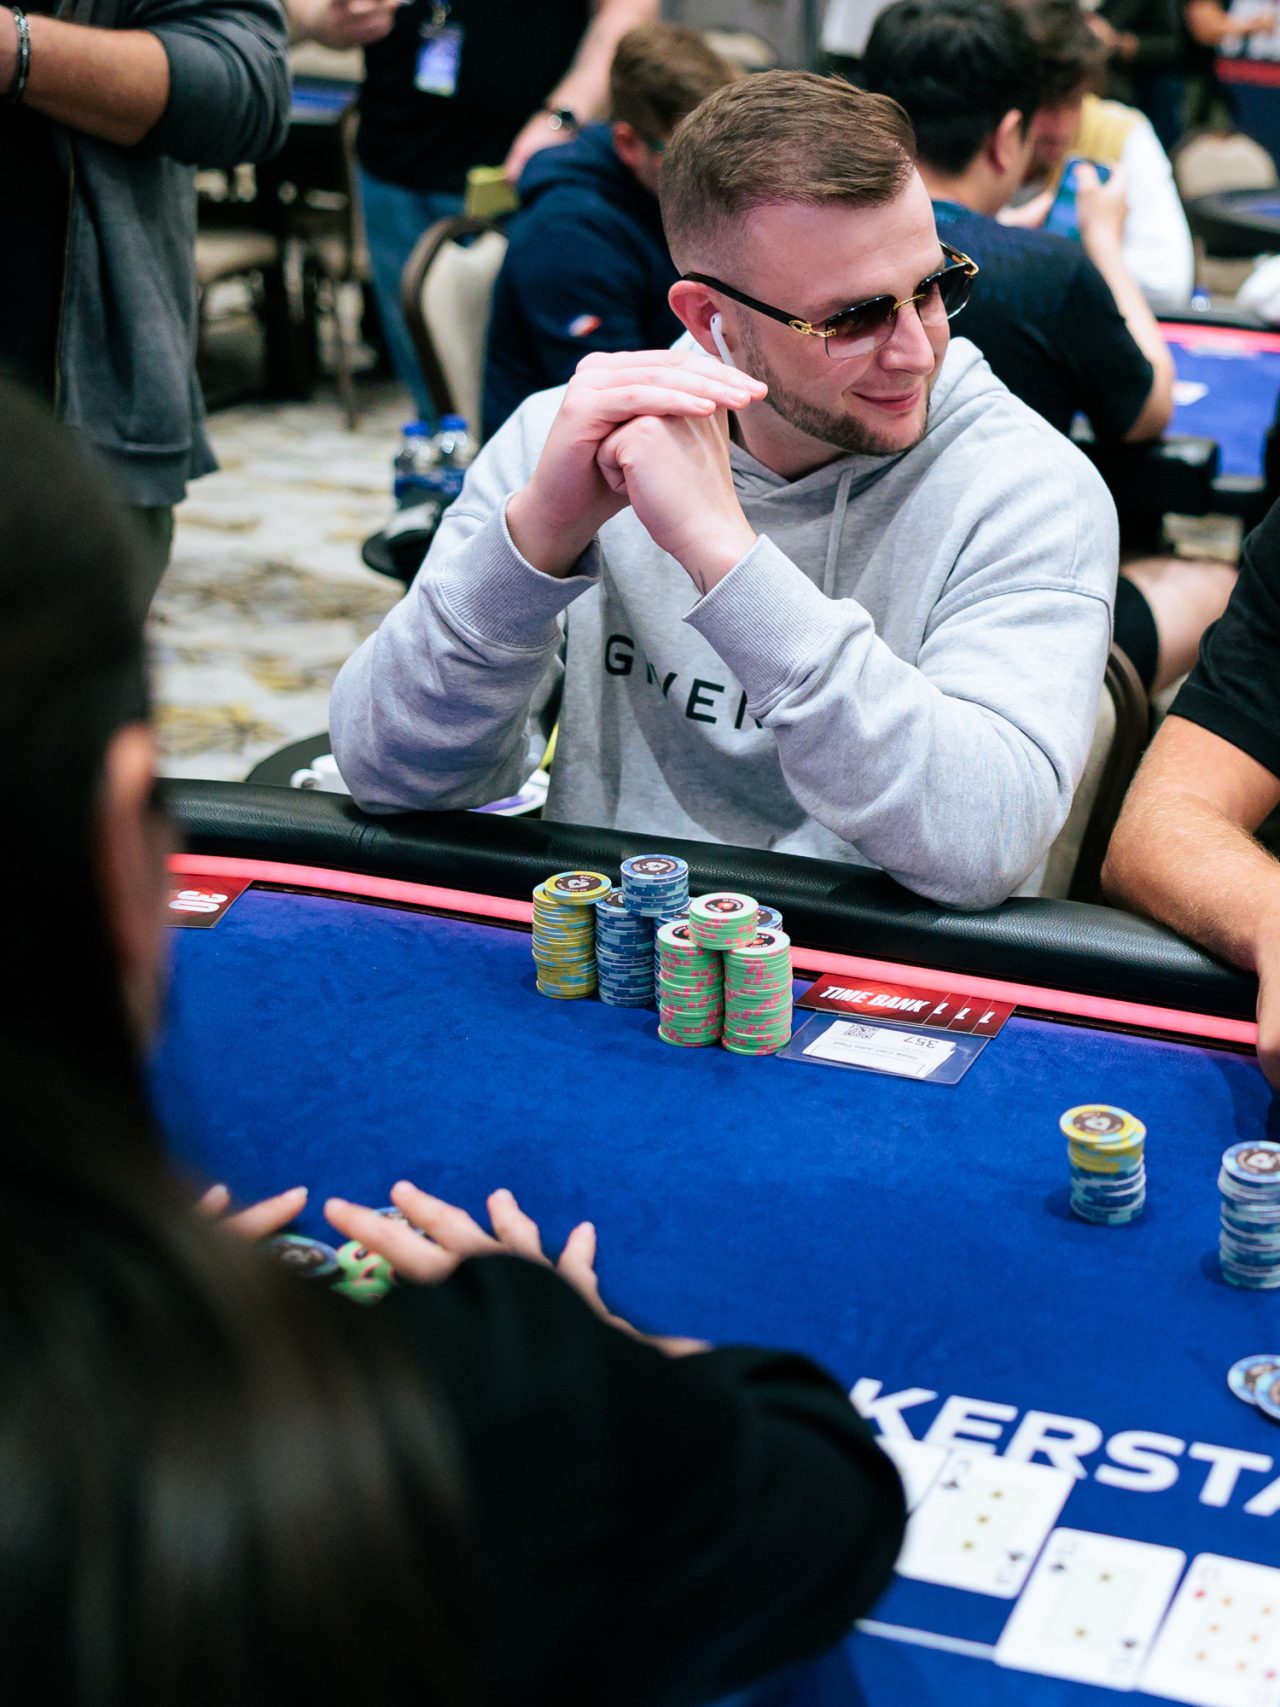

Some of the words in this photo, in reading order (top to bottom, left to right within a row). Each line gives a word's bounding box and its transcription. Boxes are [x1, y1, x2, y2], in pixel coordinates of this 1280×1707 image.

[819, 985, 871, 1005] TIME
[867, 992, 932, 1014] BANK
[904, 1035, 939, 1050] 357
